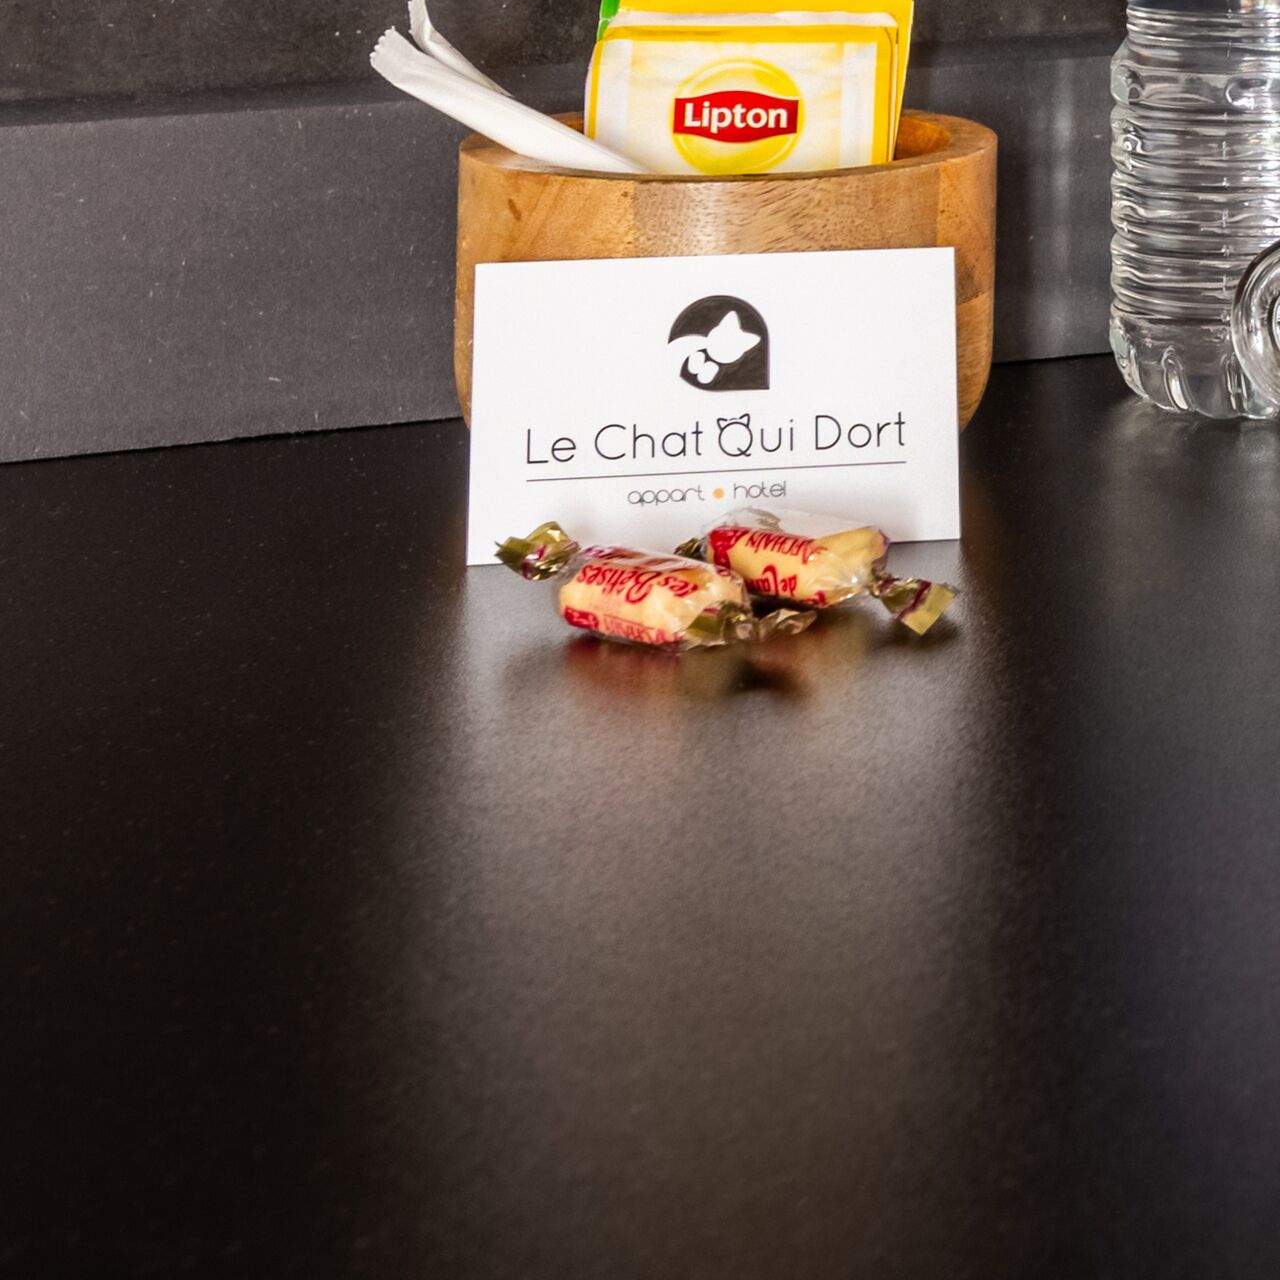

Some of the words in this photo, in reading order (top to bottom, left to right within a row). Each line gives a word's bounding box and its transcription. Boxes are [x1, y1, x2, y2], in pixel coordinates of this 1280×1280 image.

[684, 101, 788, 134] Lipton
[527, 428, 577, 464] Le
[594, 420, 703, 462] Chat
[716, 413, 795, 458] Qui
[815, 411, 907, 452] Dort
[627, 484, 706, 507] appart
[732, 480, 788, 500] hotel
[576, 564, 662, 605] Bêtises
